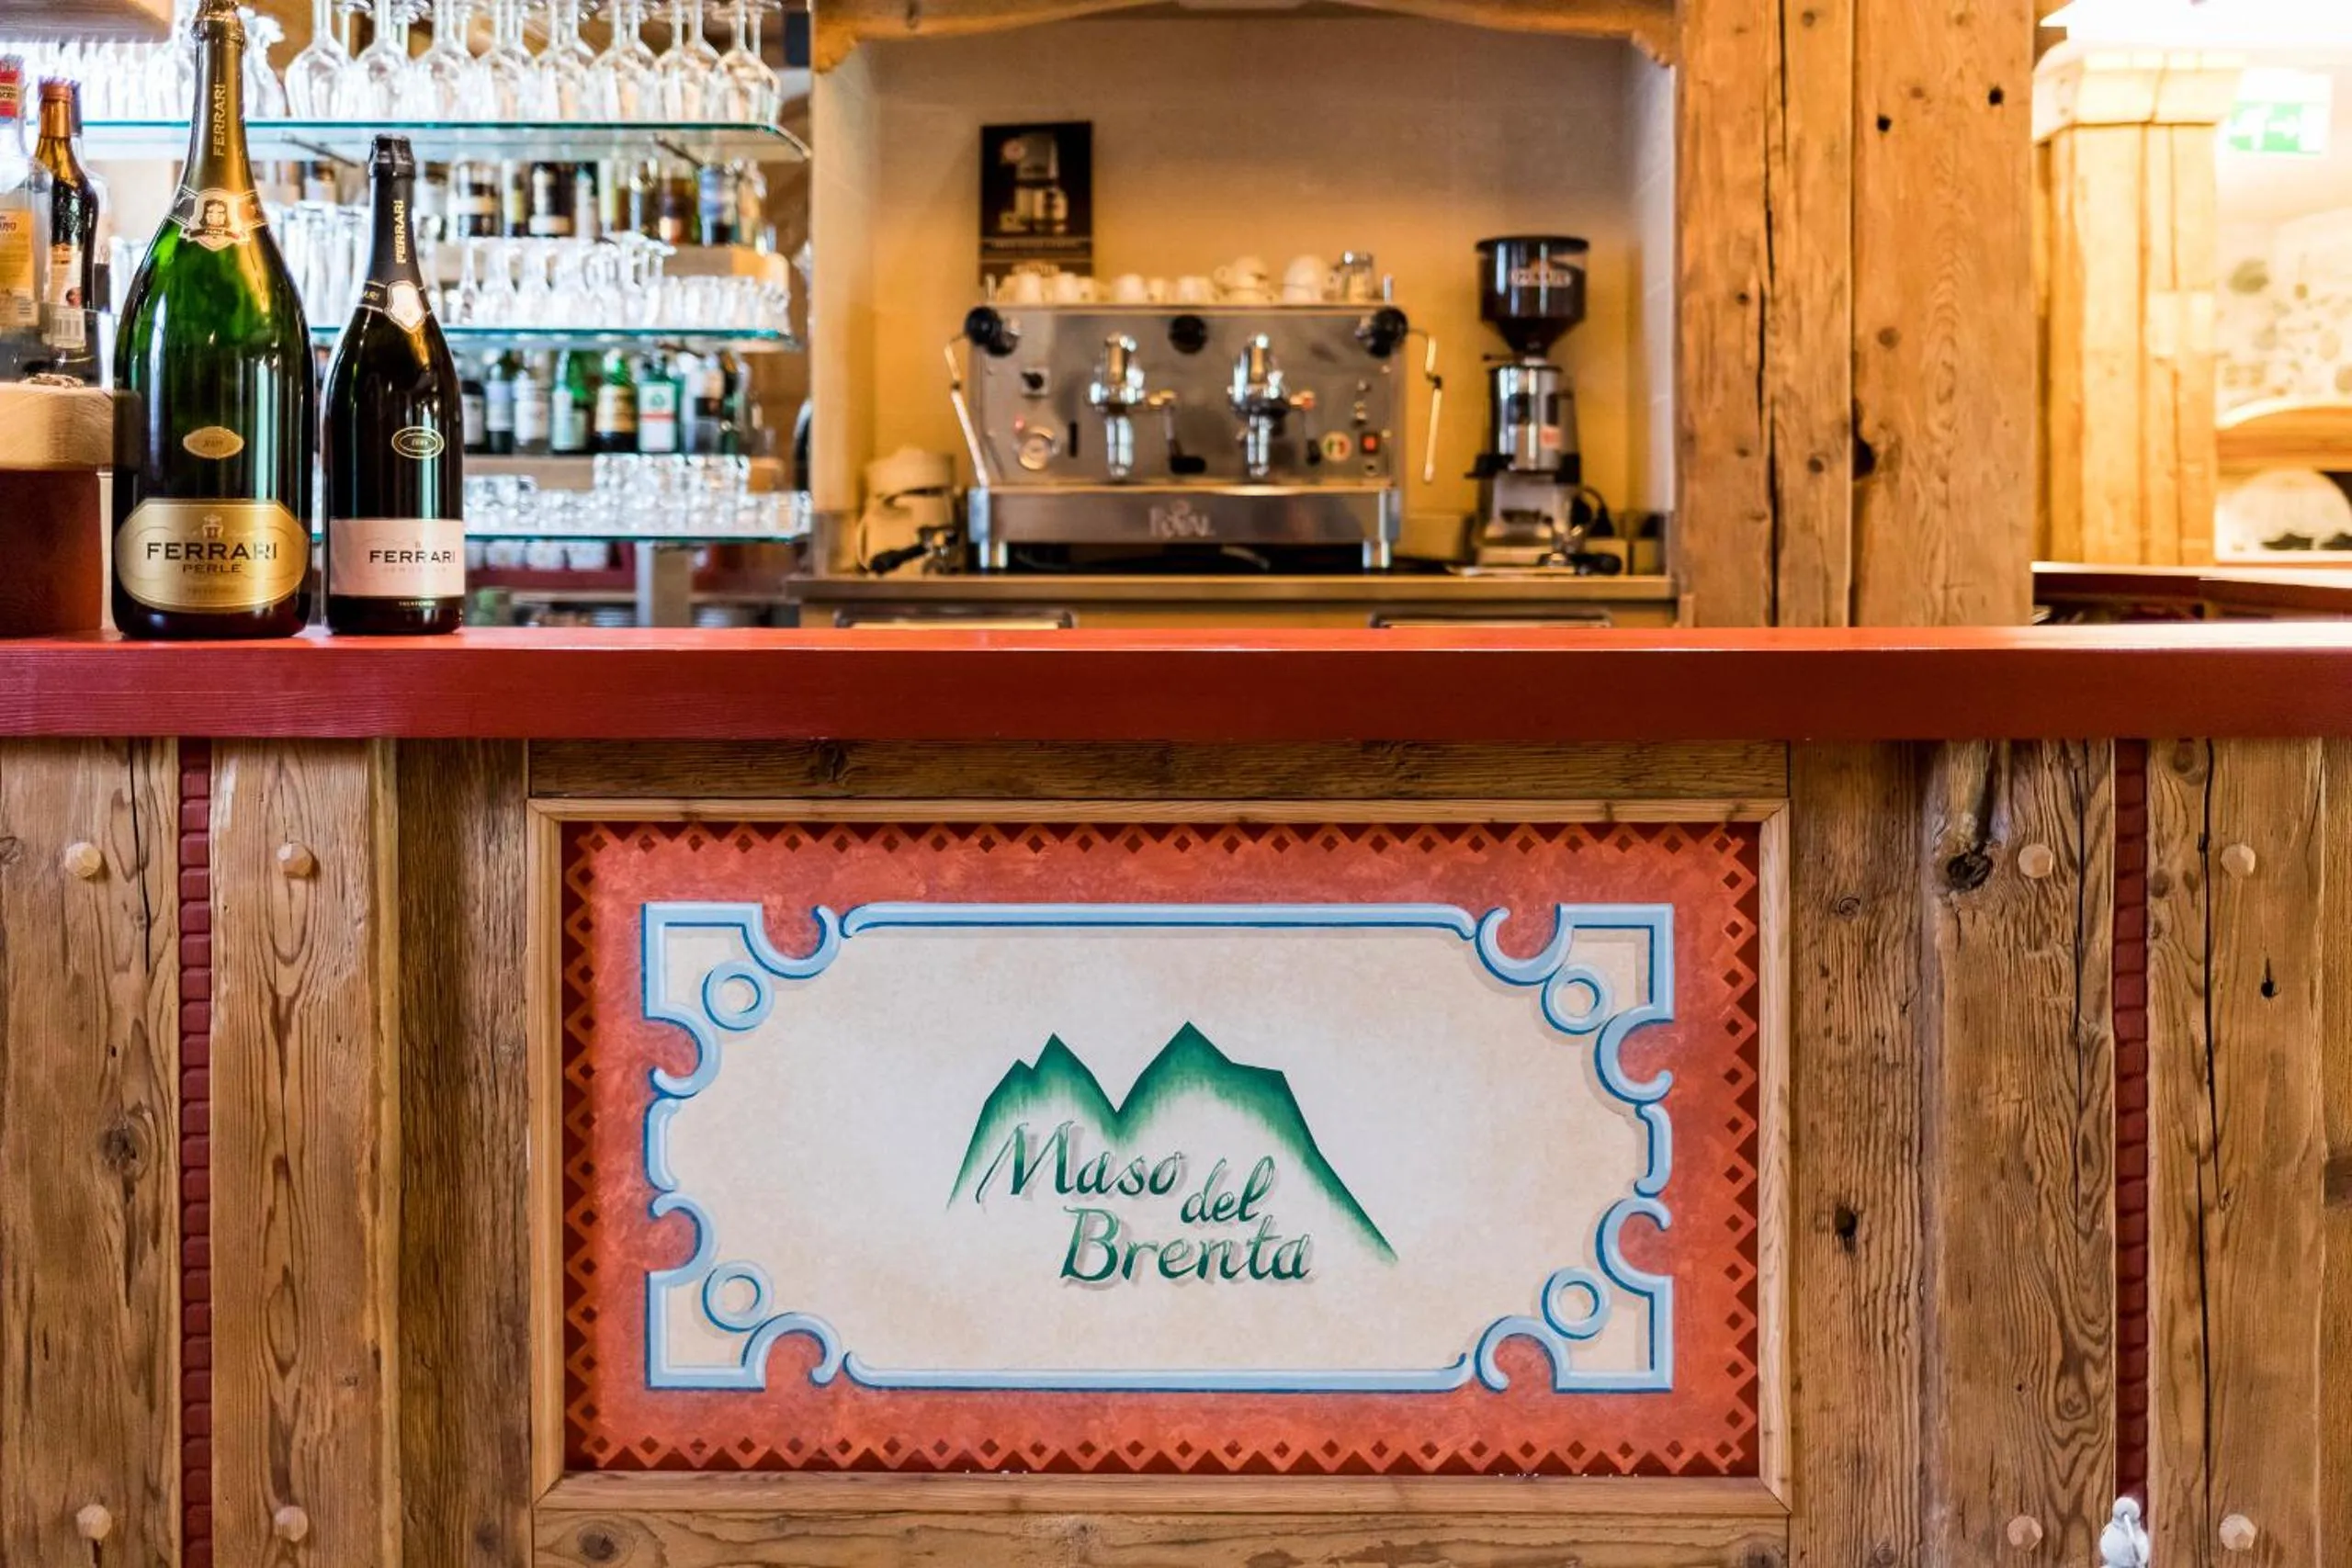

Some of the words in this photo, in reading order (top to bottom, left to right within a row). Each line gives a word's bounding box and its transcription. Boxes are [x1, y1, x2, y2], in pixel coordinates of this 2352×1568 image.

[212, 84, 226, 157] FERRARI
[393, 200, 407, 265] FERRARI
[146, 542, 277, 560] FERRARI
[369, 550, 456, 564] FERRARI
[976, 1121, 1186, 1204] Maso
[1182, 1156, 1276, 1224] del
[1060, 1205, 1311, 1282] Brenta
